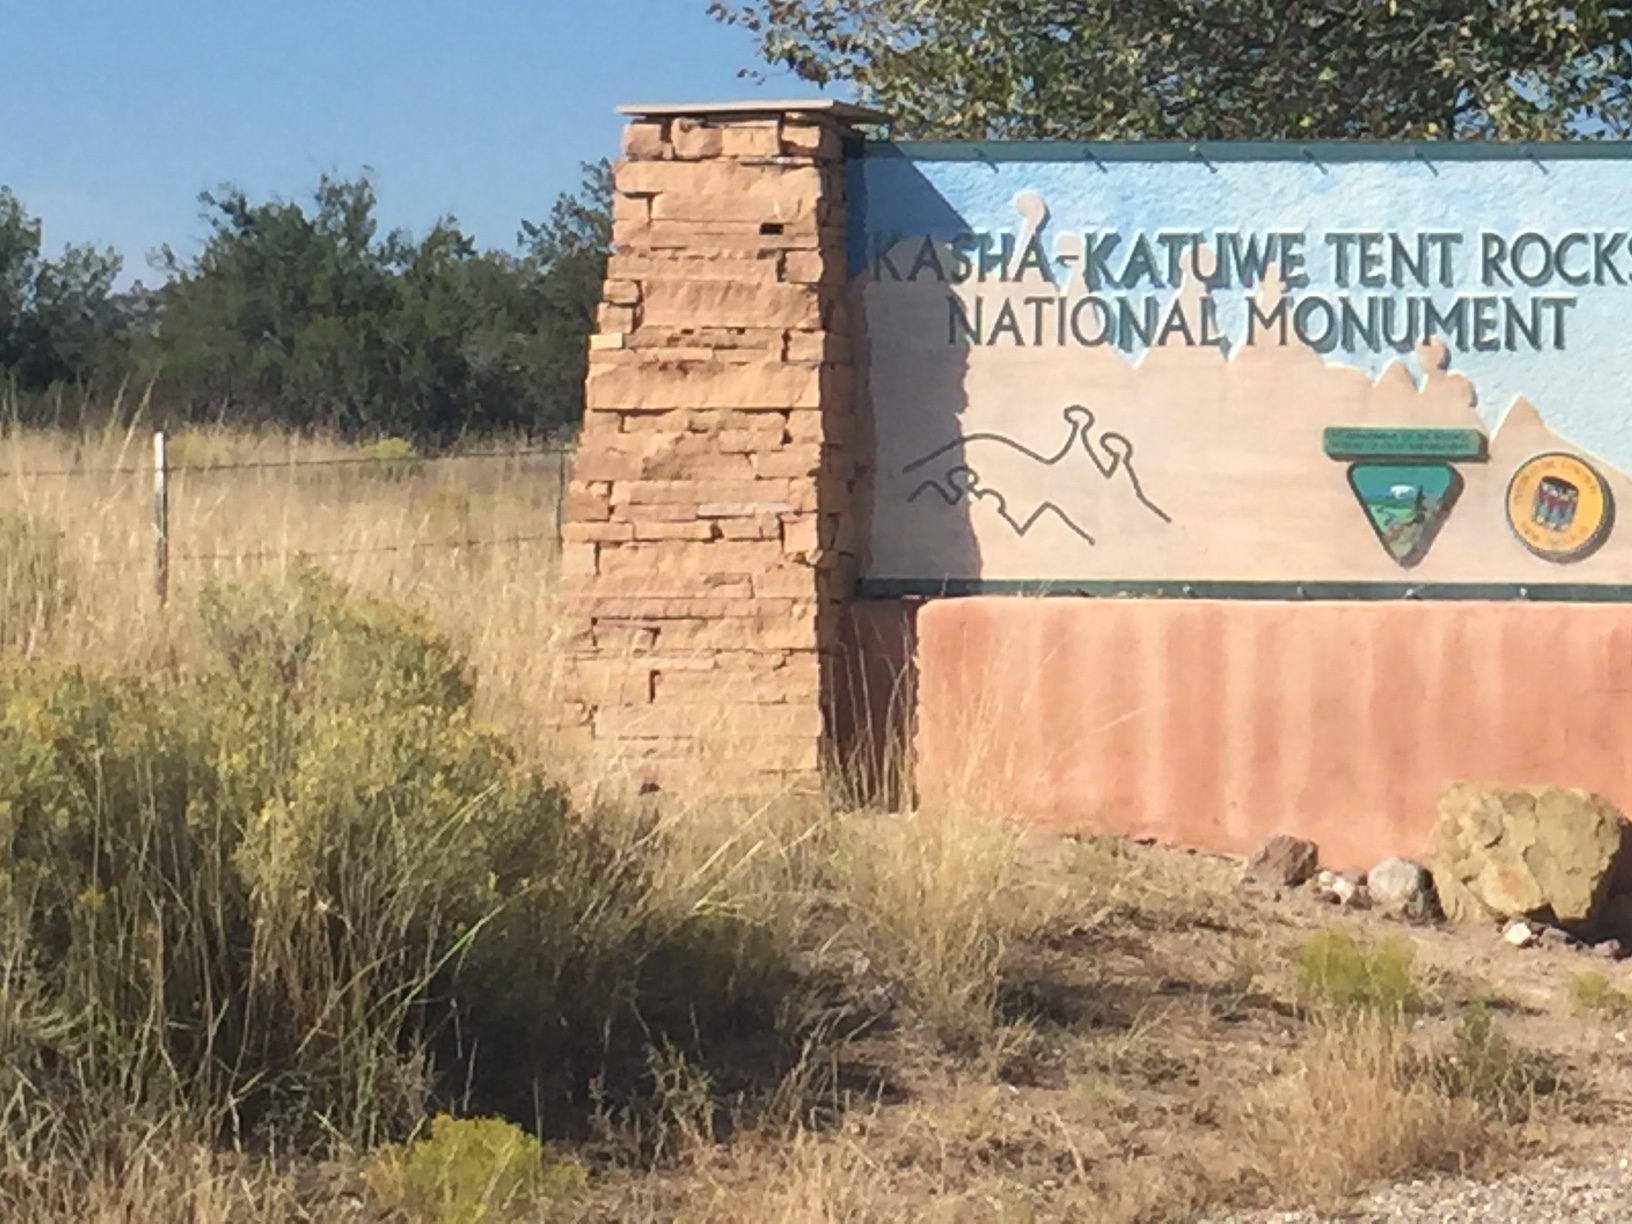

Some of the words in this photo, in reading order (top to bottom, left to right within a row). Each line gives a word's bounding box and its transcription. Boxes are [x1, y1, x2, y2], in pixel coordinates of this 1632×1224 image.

[871, 231, 1310, 291] KASHA-KATUWE
[1324, 231, 1463, 289] TENT
[946, 295, 1231, 354] NATIONAL
[1246, 295, 1577, 353] MONUMENT
